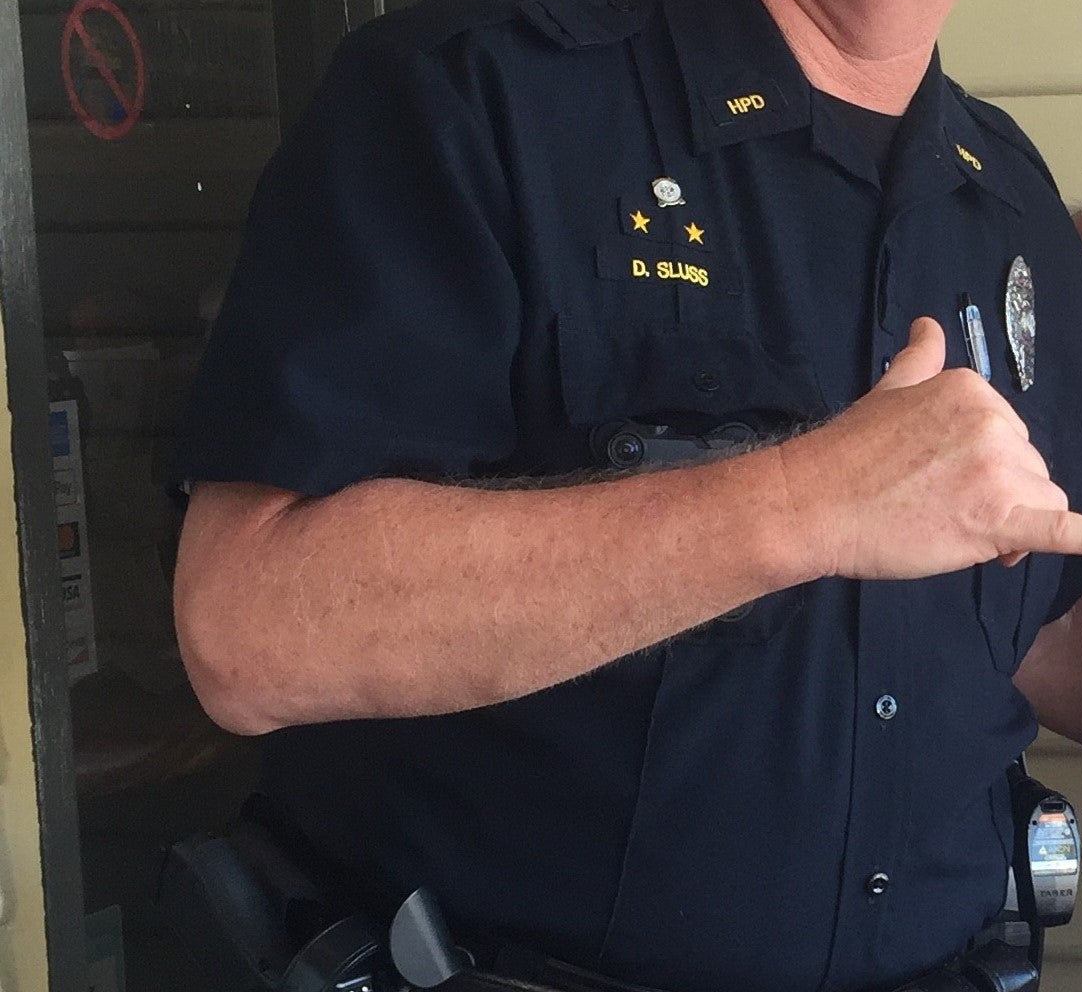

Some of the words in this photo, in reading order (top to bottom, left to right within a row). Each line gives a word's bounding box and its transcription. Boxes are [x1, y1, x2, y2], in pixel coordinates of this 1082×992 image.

[727, 94, 766, 115] HPD
[955, 144, 983, 171] HPD
[632, 259, 651, 278] D.
[657, 261, 709, 287] SLUSS
[1039, 888, 1073, 897] TASER
